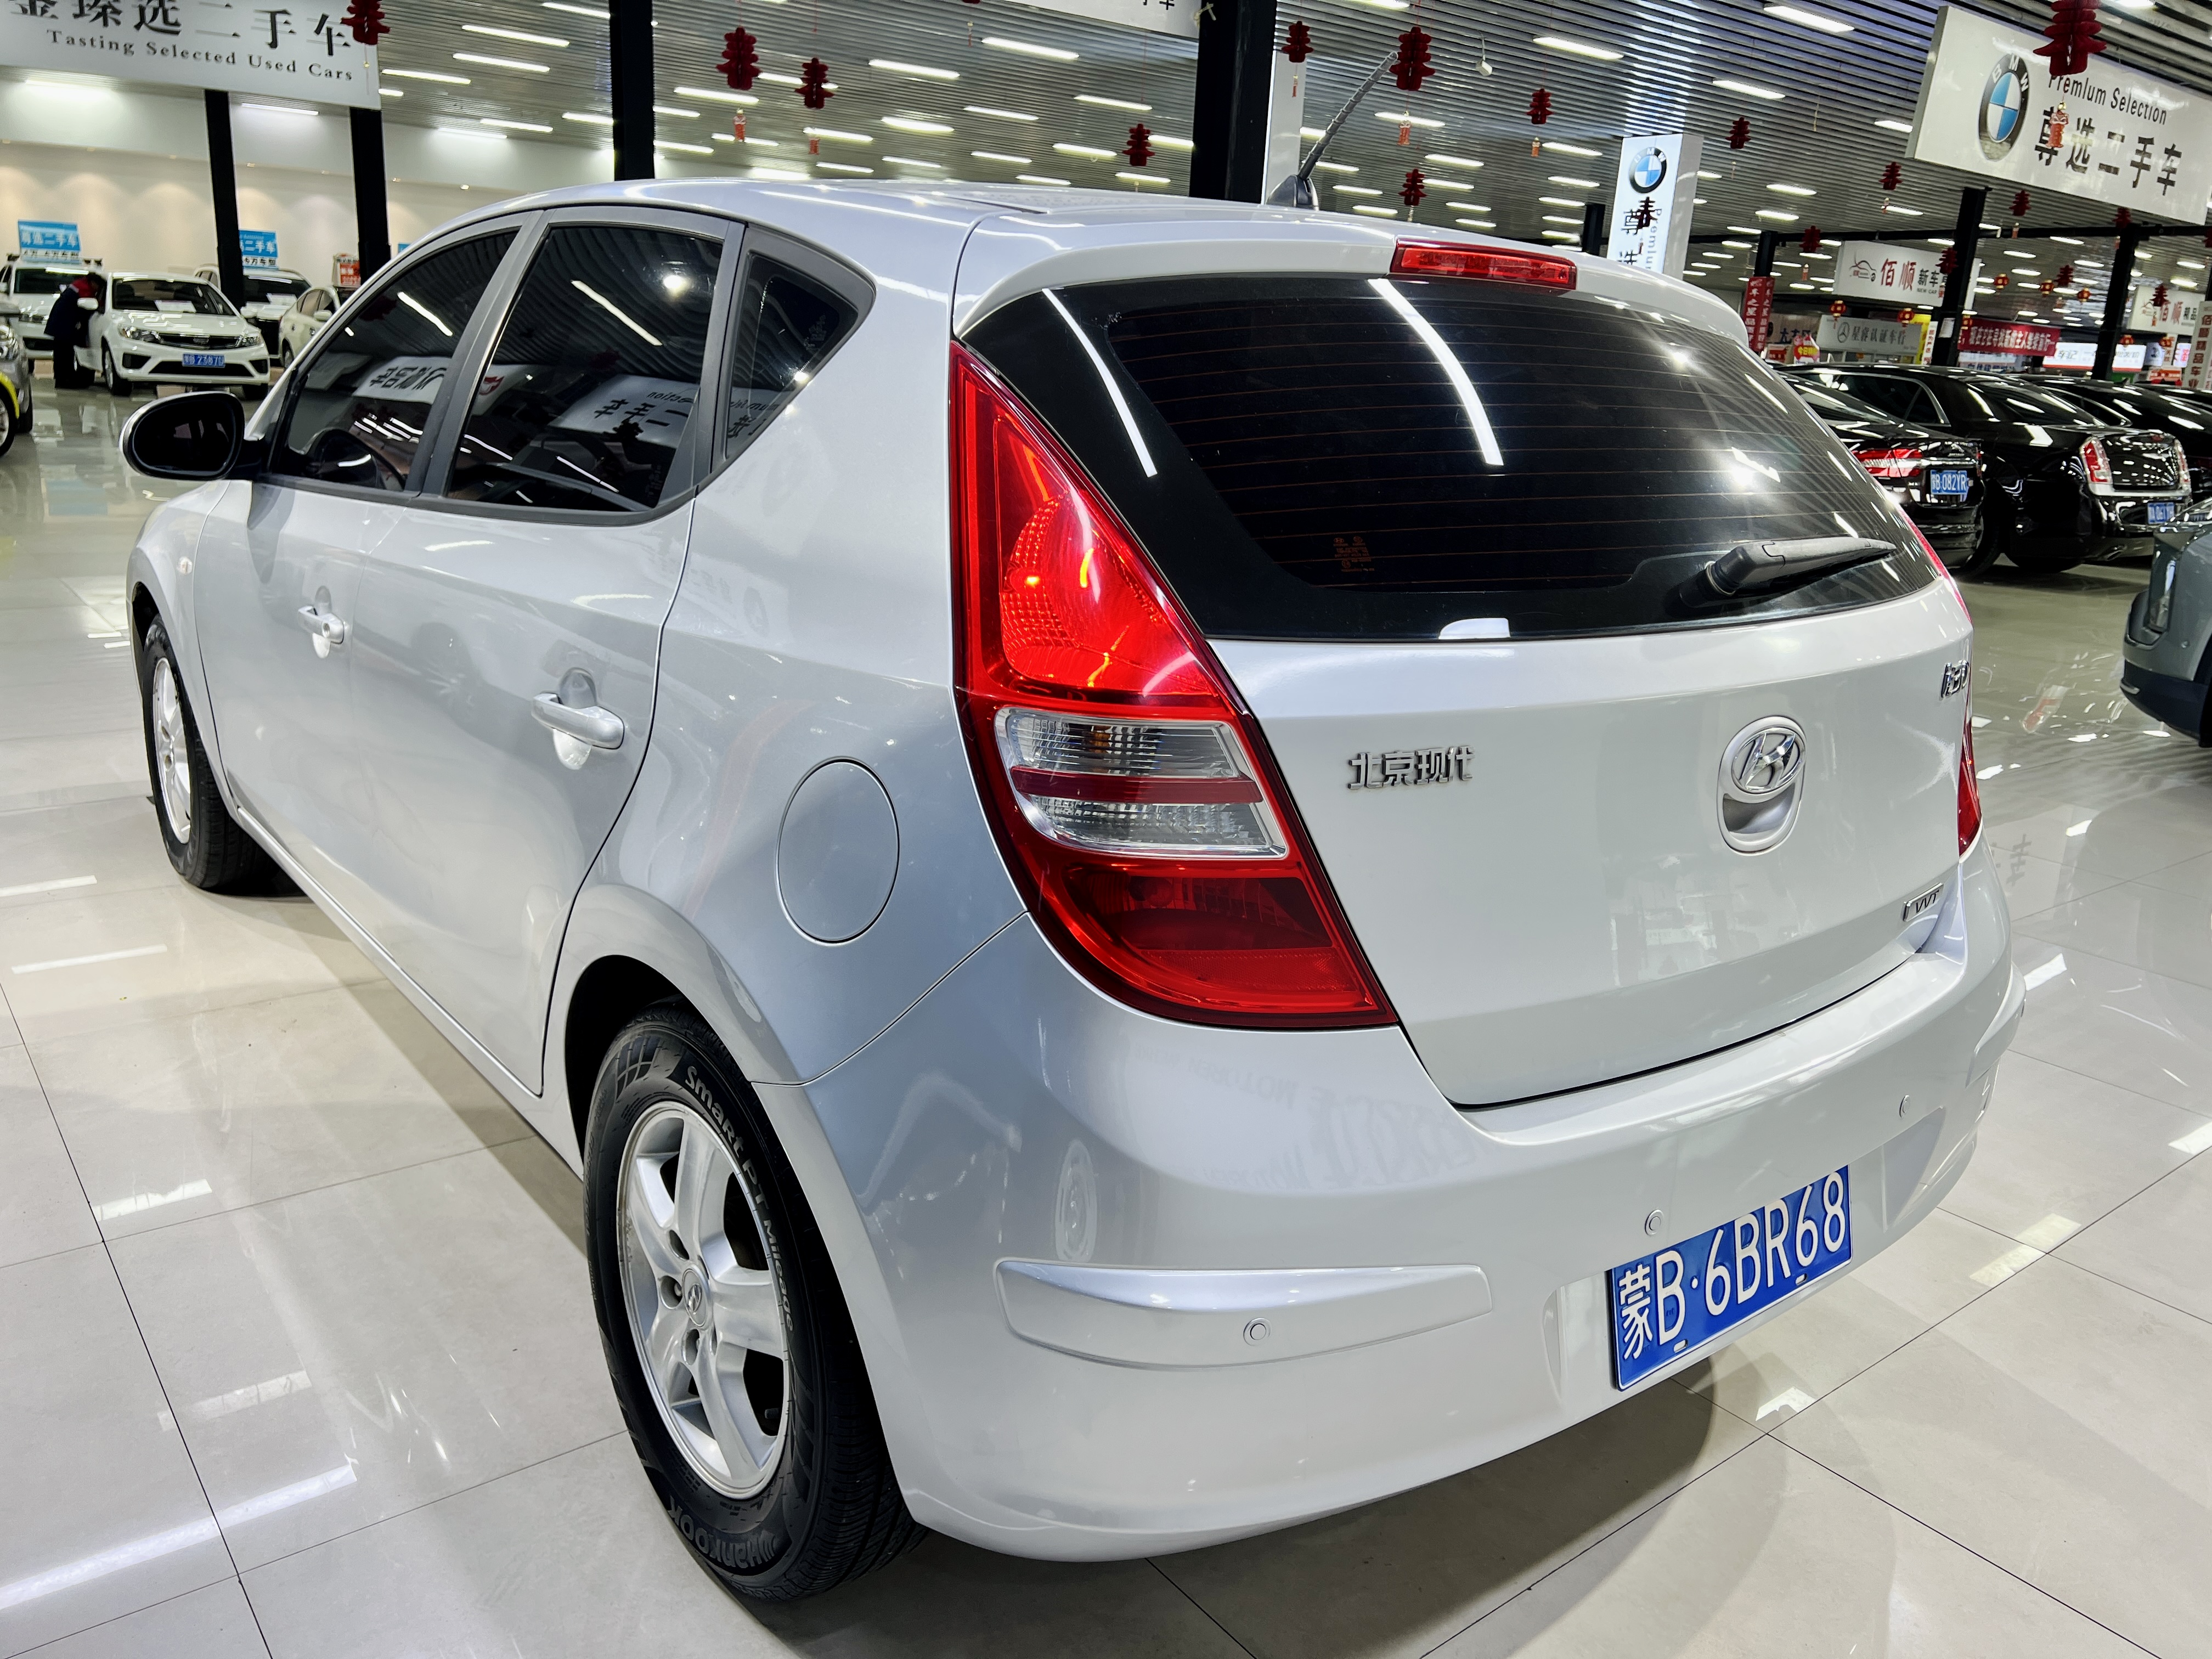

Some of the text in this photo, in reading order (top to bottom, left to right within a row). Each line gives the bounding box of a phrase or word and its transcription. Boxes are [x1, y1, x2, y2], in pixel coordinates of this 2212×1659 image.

[47, 30, 352, 81] Tasting Selected Used Cars
[1992, 55, 2029, 92] BMW
[2111, 87, 2167, 125] Selection
[1634, 146, 1667, 163] BMW
[1881, 258, 1917, 291] 佰顺
[1348, 745, 1476, 790] 北京现代
[1915, 888, 1940, 914] VVT
[763, 1218, 793, 1333] Mileage
